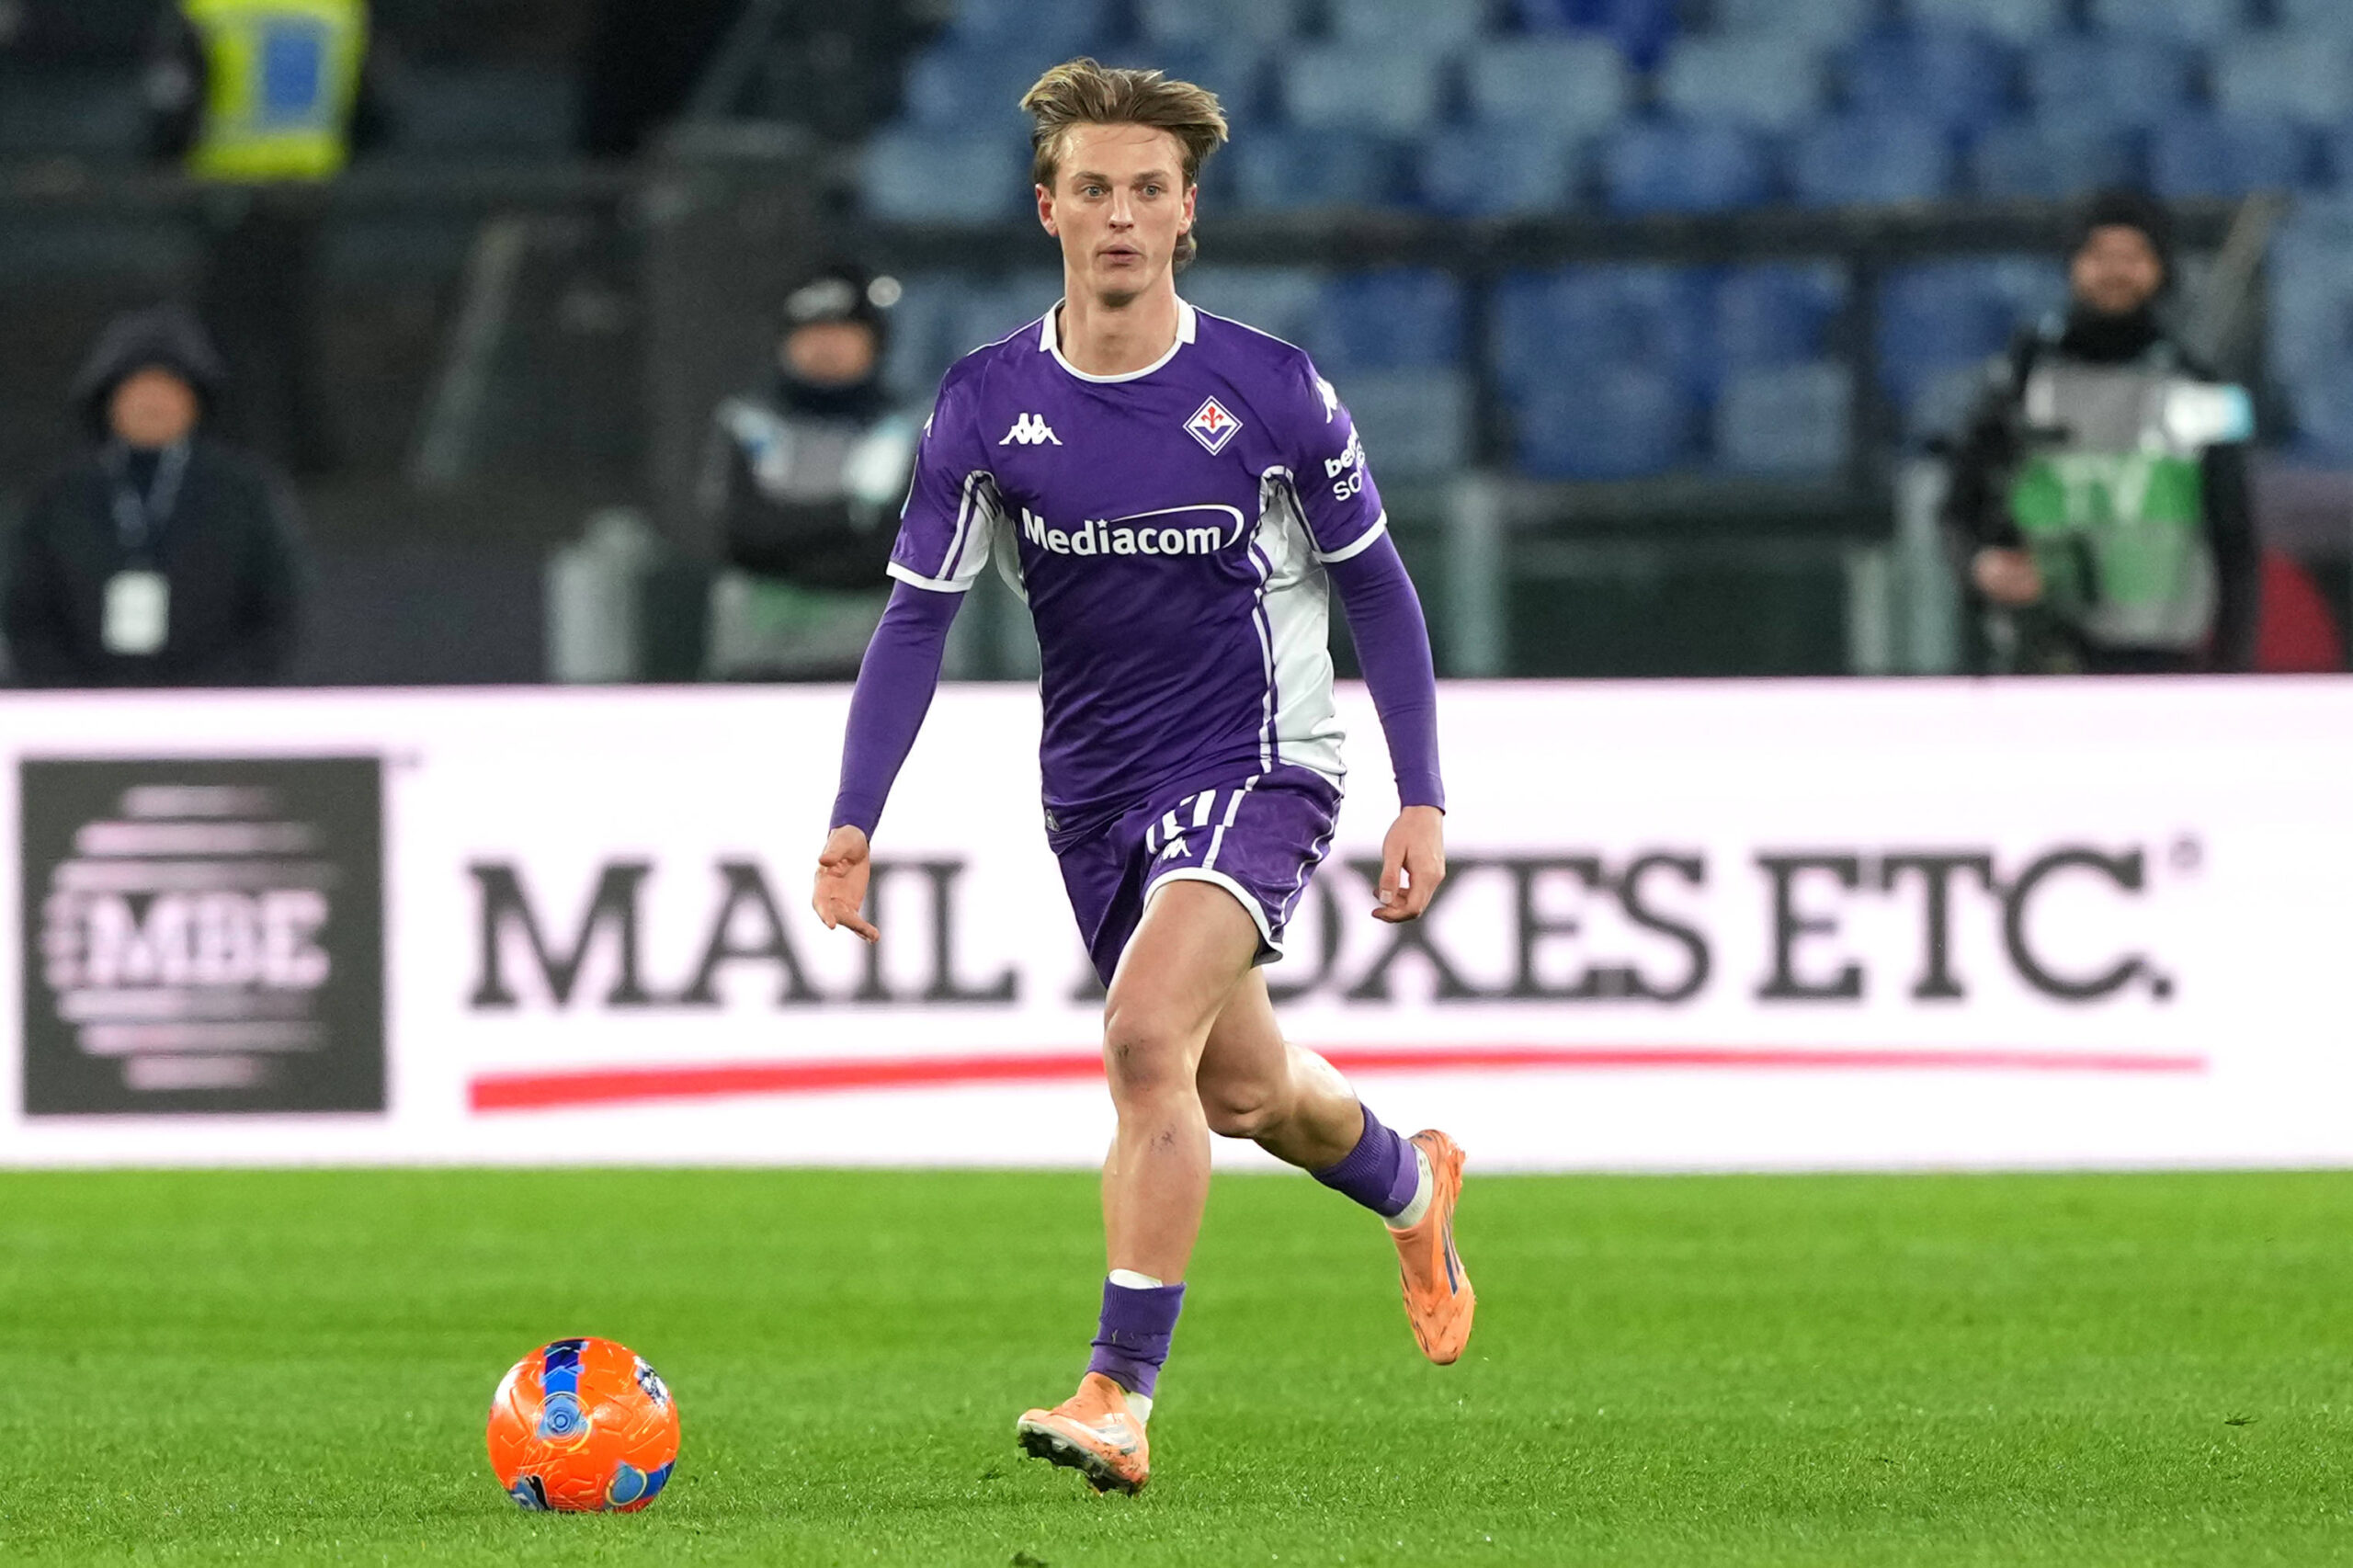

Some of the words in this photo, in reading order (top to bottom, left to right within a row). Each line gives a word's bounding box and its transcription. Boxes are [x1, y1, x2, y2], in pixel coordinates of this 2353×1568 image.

[1022, 506, 1222, 556] Mediacom
[467, 858, 1018, 1008] MAIL
[1754, 845, 2173, 1005] ETC.
